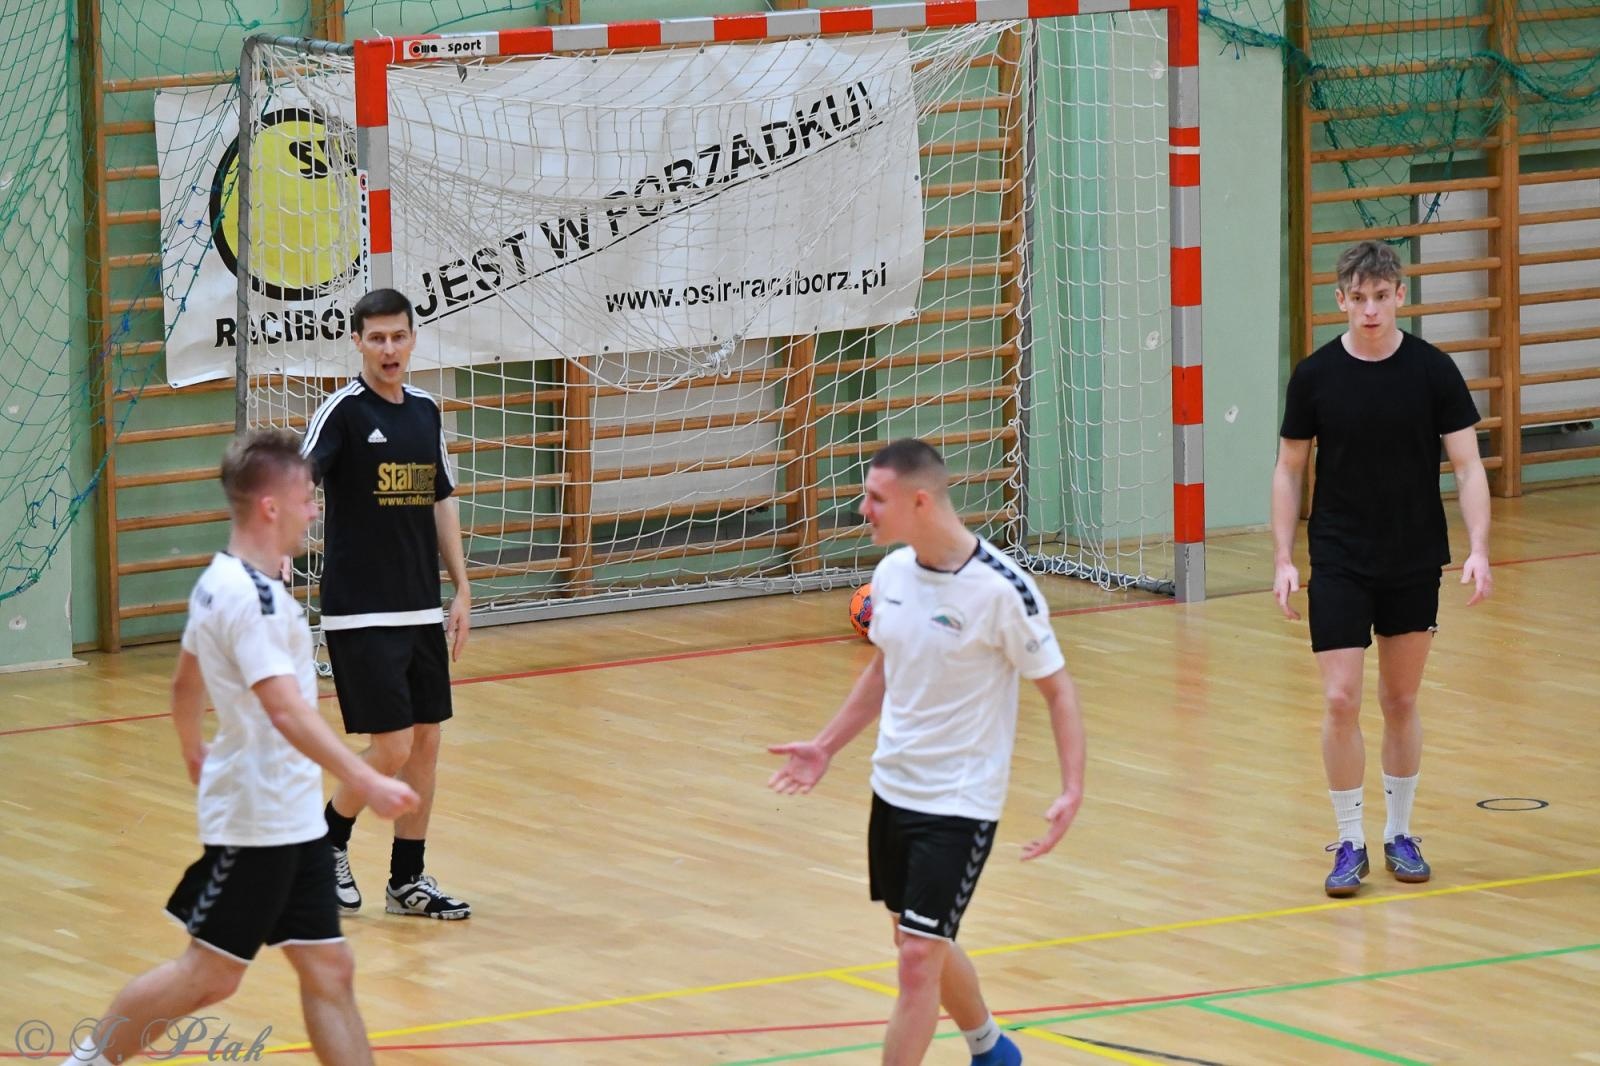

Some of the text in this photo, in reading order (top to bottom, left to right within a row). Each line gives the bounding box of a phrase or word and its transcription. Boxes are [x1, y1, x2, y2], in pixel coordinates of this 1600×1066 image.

[448, 39, 482, 54] sport
[414, 231, 527, 318] JEST
[539, 206, 591, 260] W
[605, 262, 887, 313] www.osir-raciborz.pl
